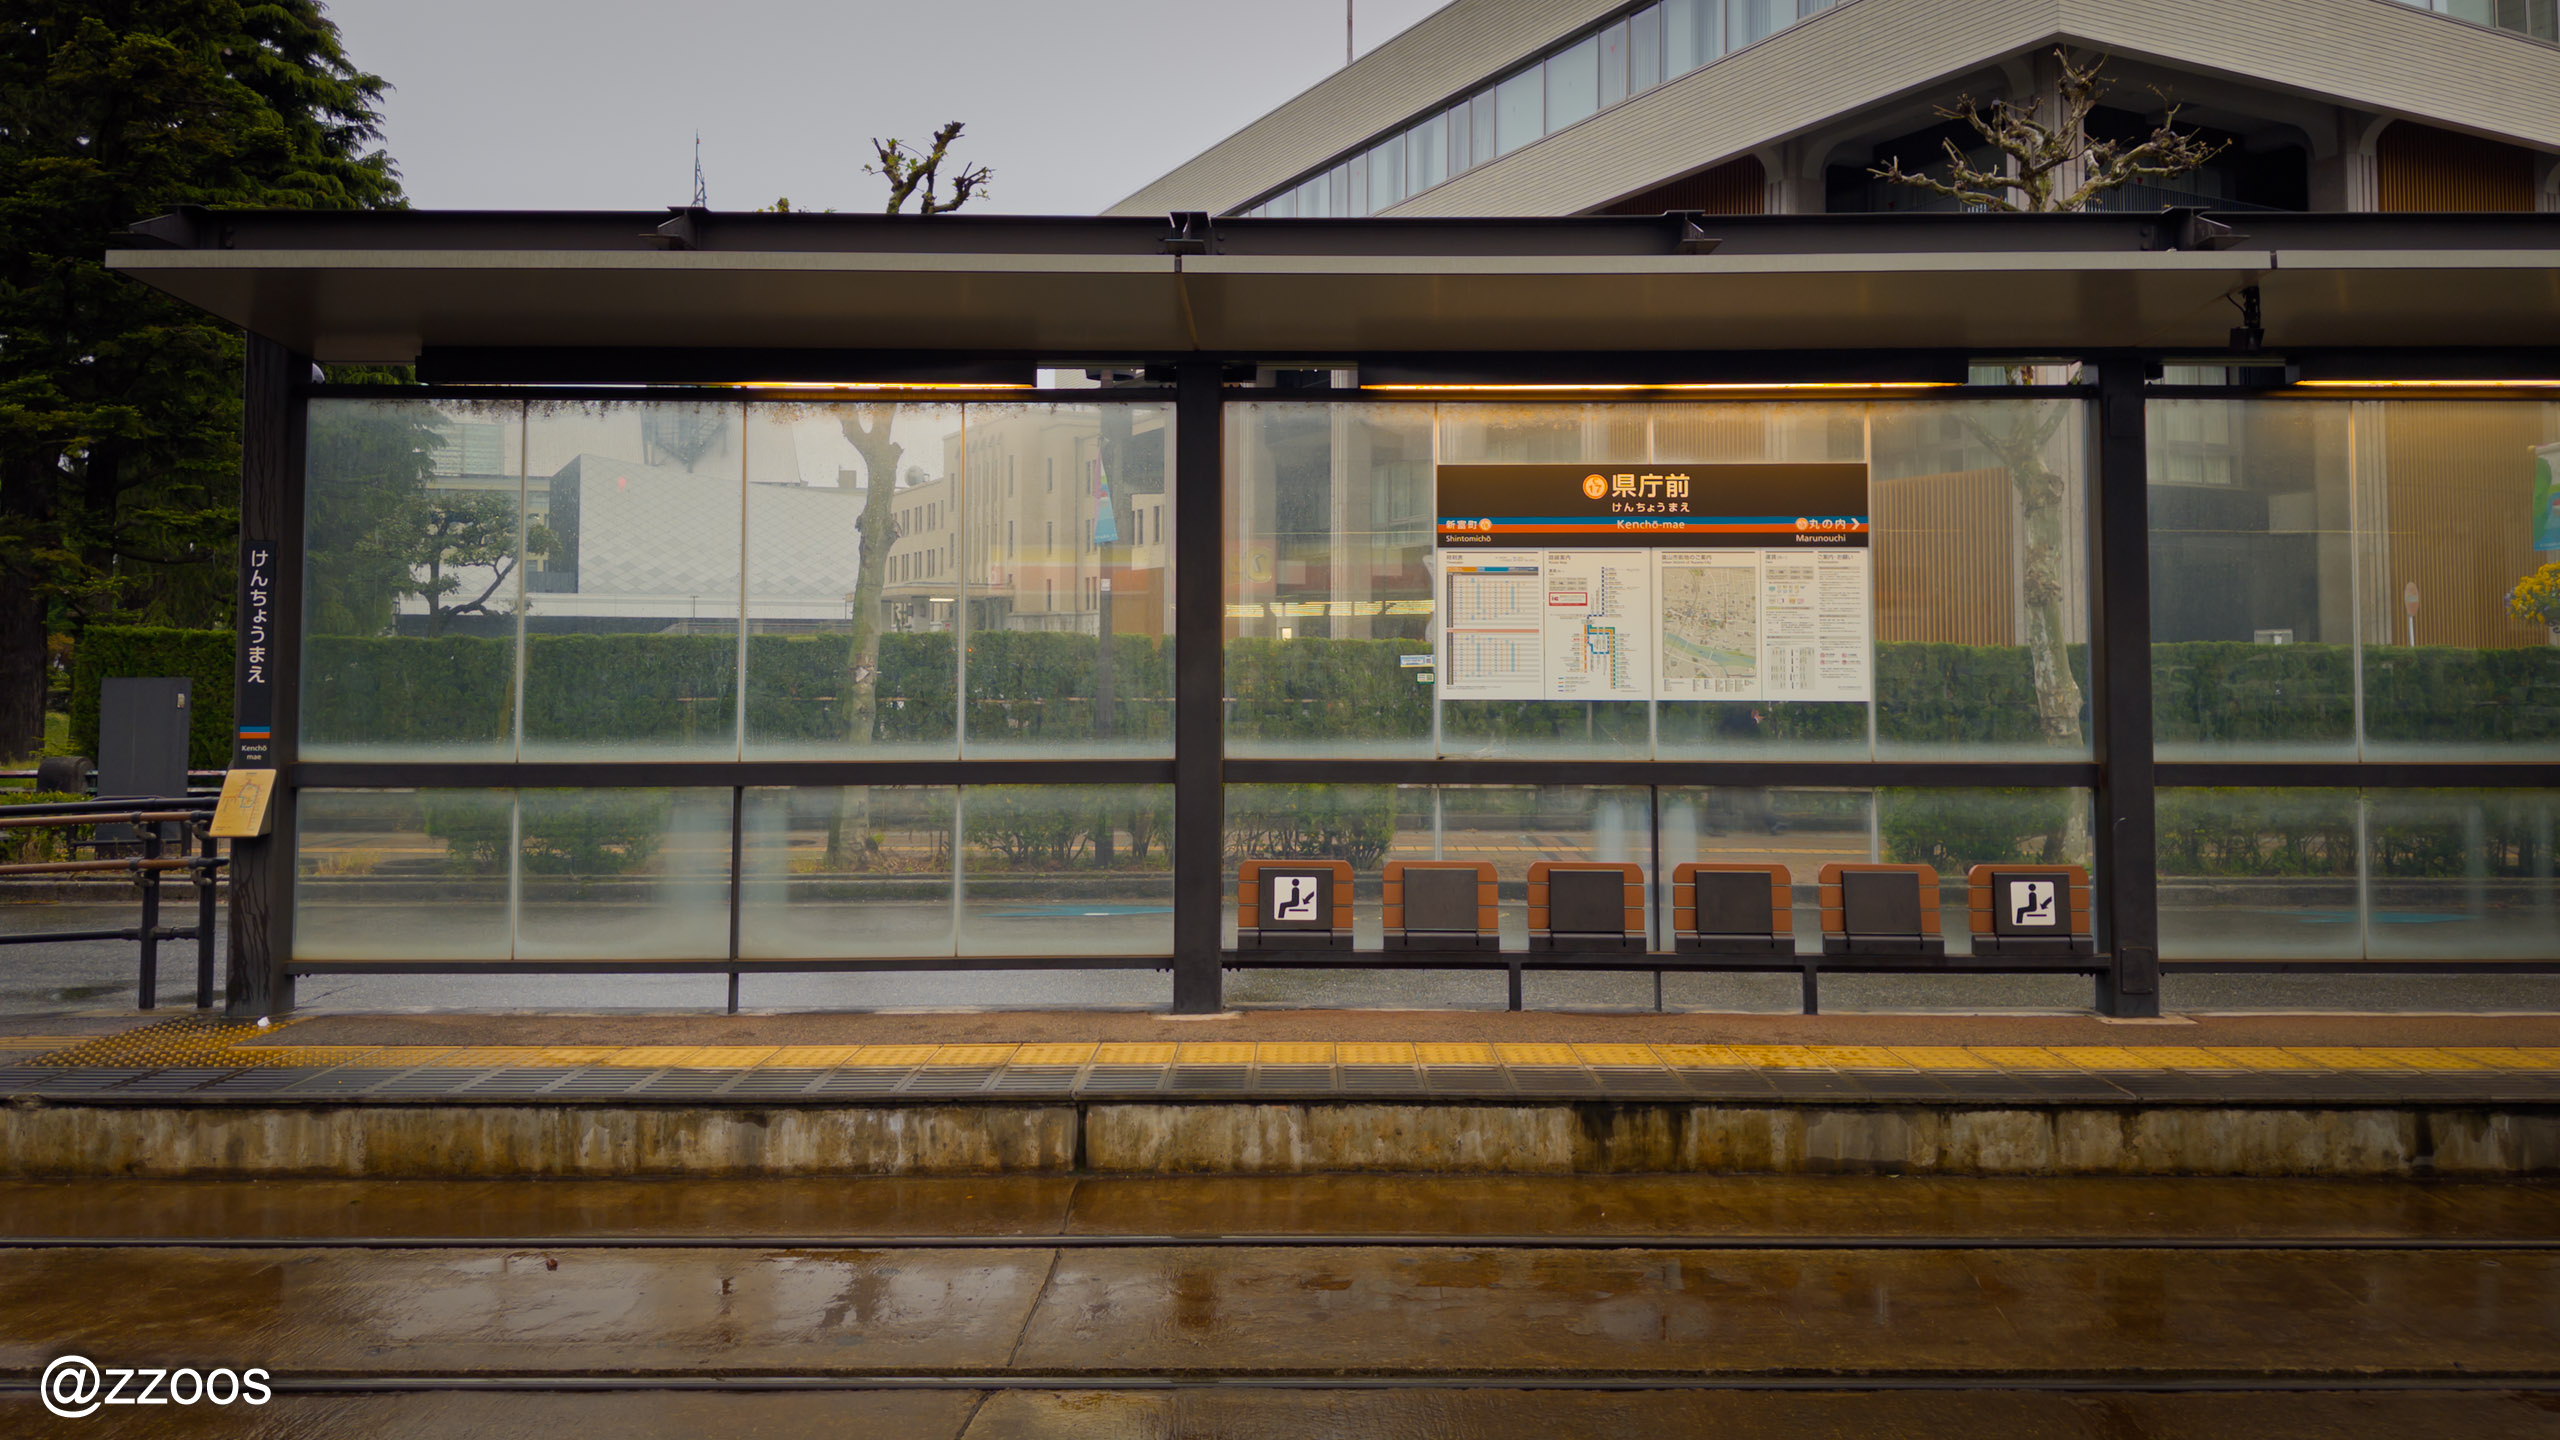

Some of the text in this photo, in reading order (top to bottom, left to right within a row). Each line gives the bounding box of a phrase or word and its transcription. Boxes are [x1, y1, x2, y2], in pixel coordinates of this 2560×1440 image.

[1588, 484, 1602, 494] 17
[1611, 473, 1691, 498] 県庁前
[1611, 502, 1691, 513] けんちょうまえ
[1446, 520, 1478, 530] 新富町
[1616, 519, 1686, 530] Kenchō-mae
[1808, 518, 1846, 530] 丸の内
[1445, 534, 1492, 543] Shintomichō
[1795, 533, 1847, 542] Marunouchi
[247, 549, 269, 684] けんちょうまえ
[241, 744, 268, 752] Kenchō
